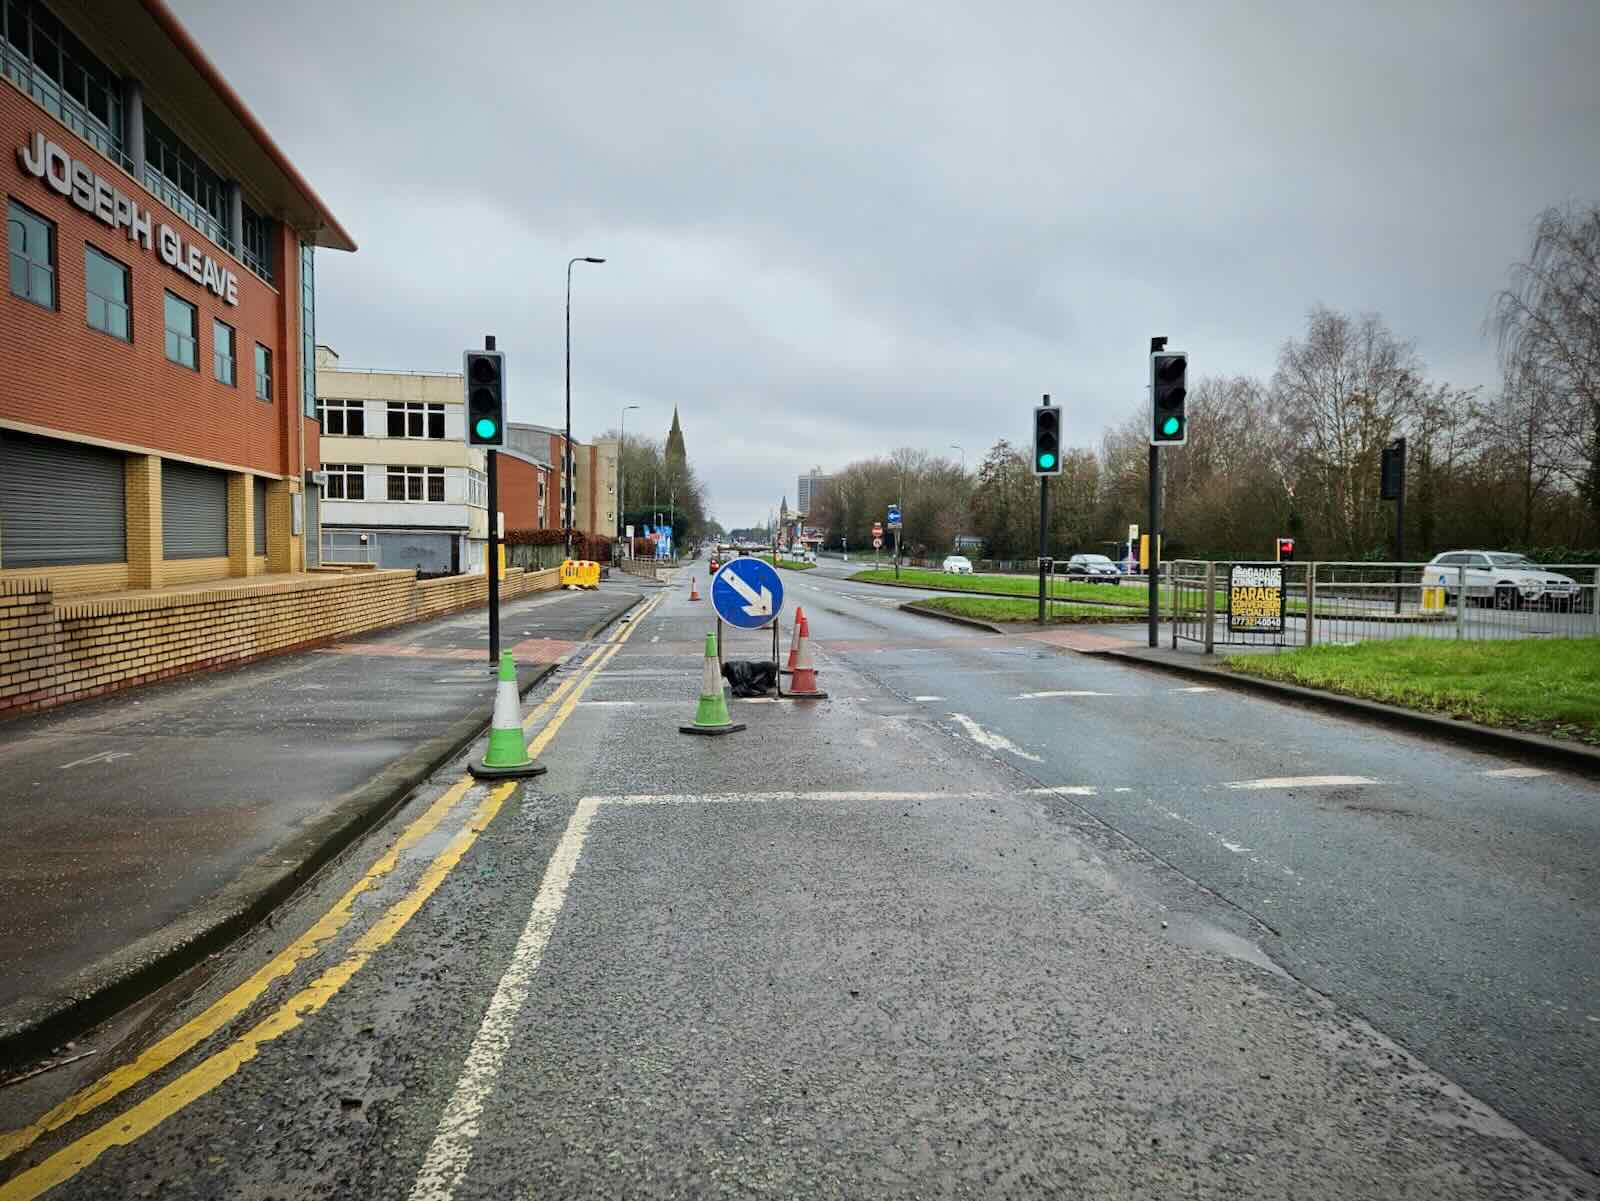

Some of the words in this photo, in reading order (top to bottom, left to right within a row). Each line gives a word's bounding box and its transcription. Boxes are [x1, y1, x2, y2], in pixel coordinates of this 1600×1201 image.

[18, 131, 152, 250] JOSEPH
[156, 224, 239, 306] GLEAVE
[1248, 568, 1282, 578] GARAGE
[1232, 587, 1281, 600] GARAGE
[1232, 600, 1281, 609] CONVERSION
[1232, 608, 1280, 617] SPECIALISTS
